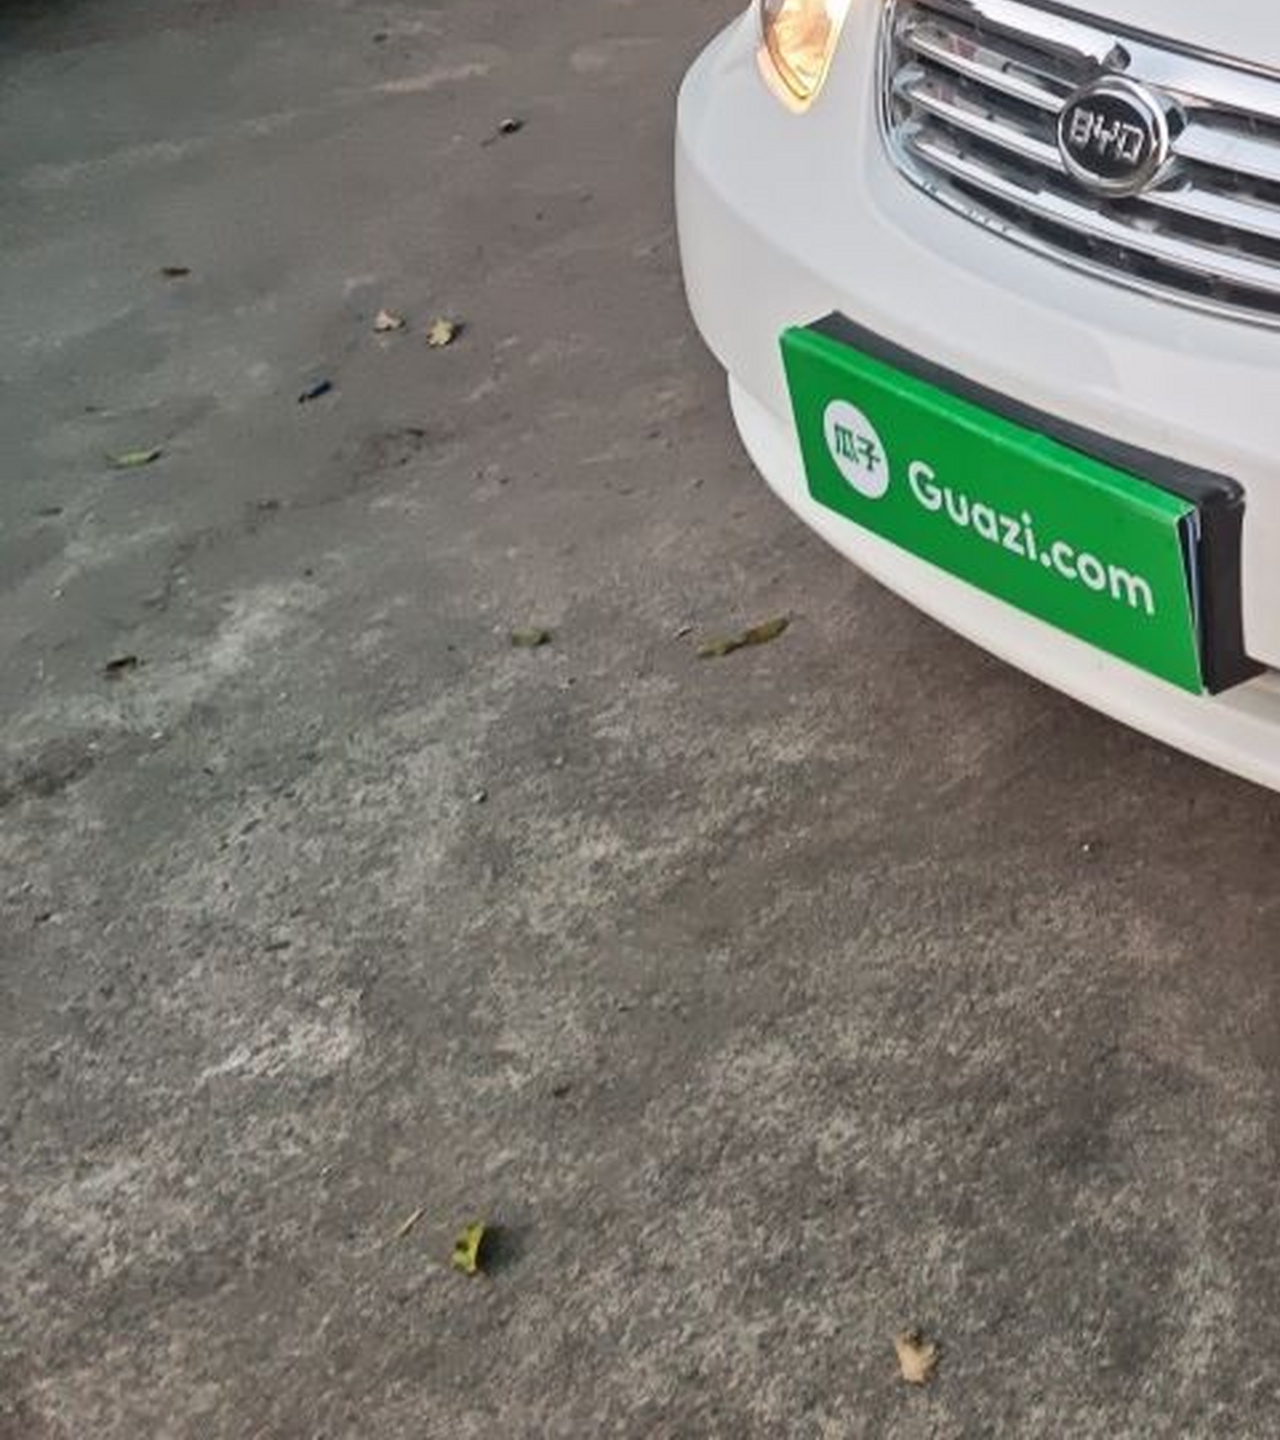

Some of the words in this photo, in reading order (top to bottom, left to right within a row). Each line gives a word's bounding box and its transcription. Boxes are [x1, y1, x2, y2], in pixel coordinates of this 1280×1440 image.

[1071, 107, 1144, 163] BYD
[834, 425, 880, 471] 瓜子
[909, 461, 1154, 616] Guazi.com
